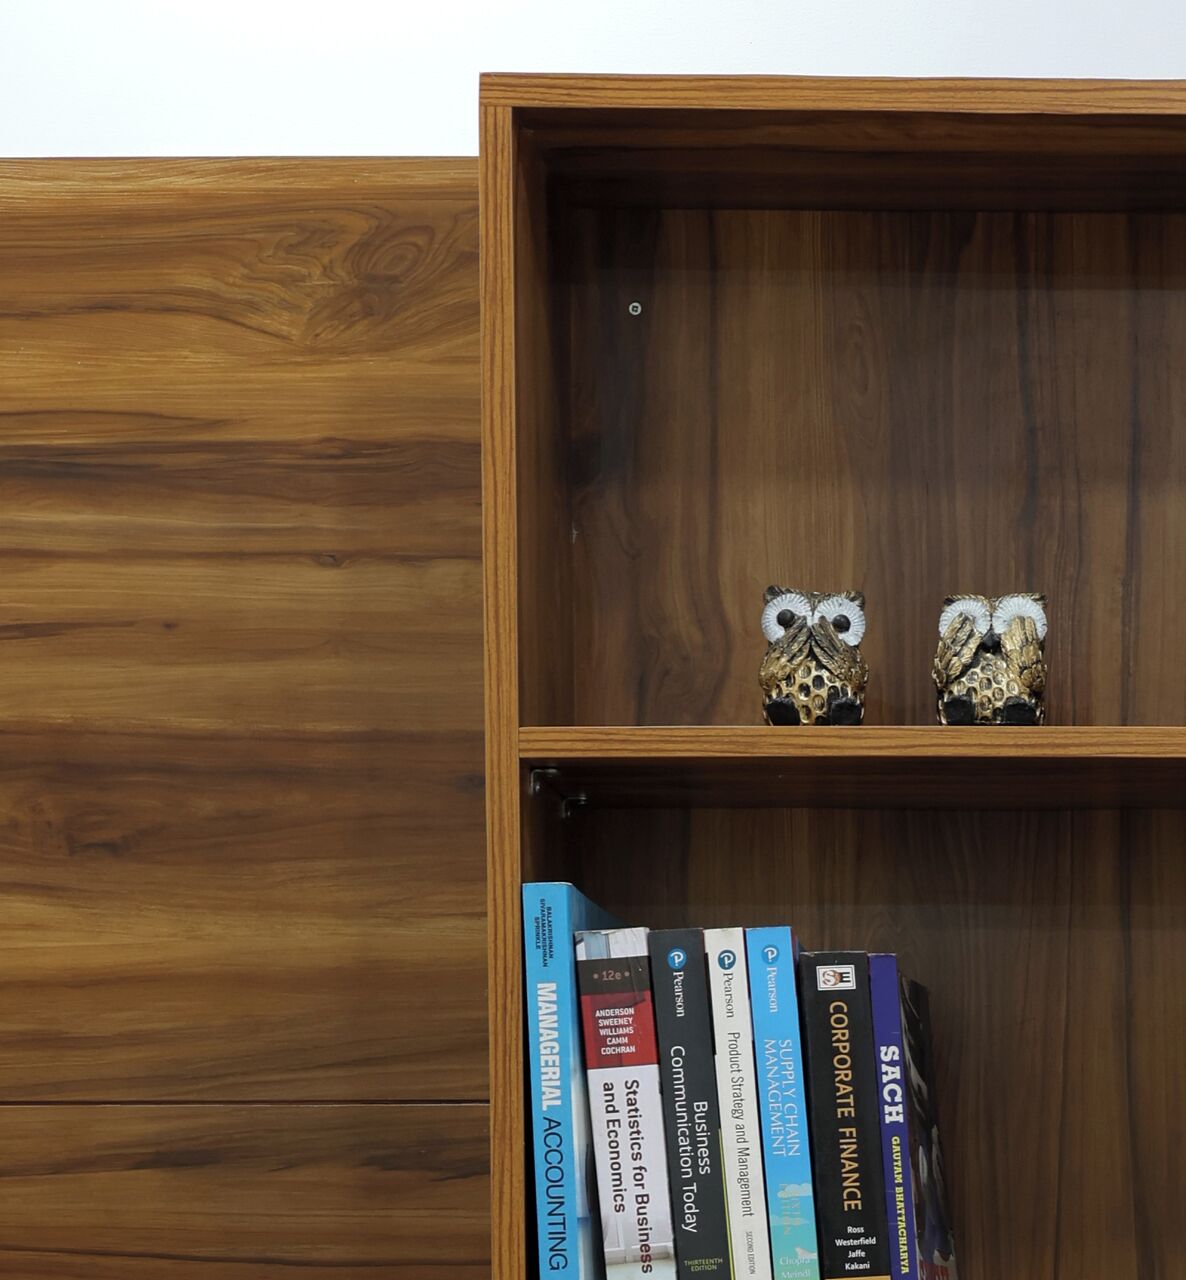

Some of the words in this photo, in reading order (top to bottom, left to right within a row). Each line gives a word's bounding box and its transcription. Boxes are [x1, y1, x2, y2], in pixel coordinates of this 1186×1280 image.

[595, 1007, 634, 1017] ANDERSON
[673, 971, 685, 1017] Pearson
[723, 972, 735, 1018] Pearson
[766, 967, 778, 1013] Pearson
[598, 1017, 633, 1027] SWEENEY
[599, 1027, 634, 1036] WILLIAMS
[606, 1037, 628, 1045] CAMM
[536, 982, 561, 1111] MANAGERIAL
[601, 1046, 636, 1055] COCHRAN
[727, 1032, 742, 1073] Product
[778, 1040, 795, 1098] SUPPLY
[829, 1001, 854, 1118] CORPORATE
[602, 1082, 619, 1114] and
[730, 1077, 745, 1120] Strategy
[763, 1040, 785, 1157] MANAGEMENT
[879, 1045, 903, 1124] SACH
[624, 1079, 645, 1162] Statistics
[670, 1046, 695, 1178] Communication
[735, 1124, 749, 1144] and
[784, 1103, 800, 1156] CHAIN
[692, 1102, 711, 1174] Business
[891, 1136, 902, 1183] GAUTAM
[605, 1119, 627, 1213] Economics
[632, 1165, 647, 1190] for
[736, 1147, 754, 1217] Management
[838, 1128, 861, 1211] FINANCE
[542, 1116, 567, 1271] ACCOUNTING
[680, 1183, 698, 1233] Today
[634, 1193, 652, 1273] Business
[745, 1231, 753, 1253] SECOND
[835, 1236, 876, 1247] Westerfield
[847, 1226, 864, 1234] Ross
[894, 1187, 909, 1274] BHATTACHARYA
[684, 1258, 723, 1266] THIRTEENTH
[691, 1264, 717, 1272] EDITION
[747, 1254, 755, 1275] EDITION
[845, 1261, 870, 1270] Kakani
[848, 1249, 866, 1258] Jaffe
